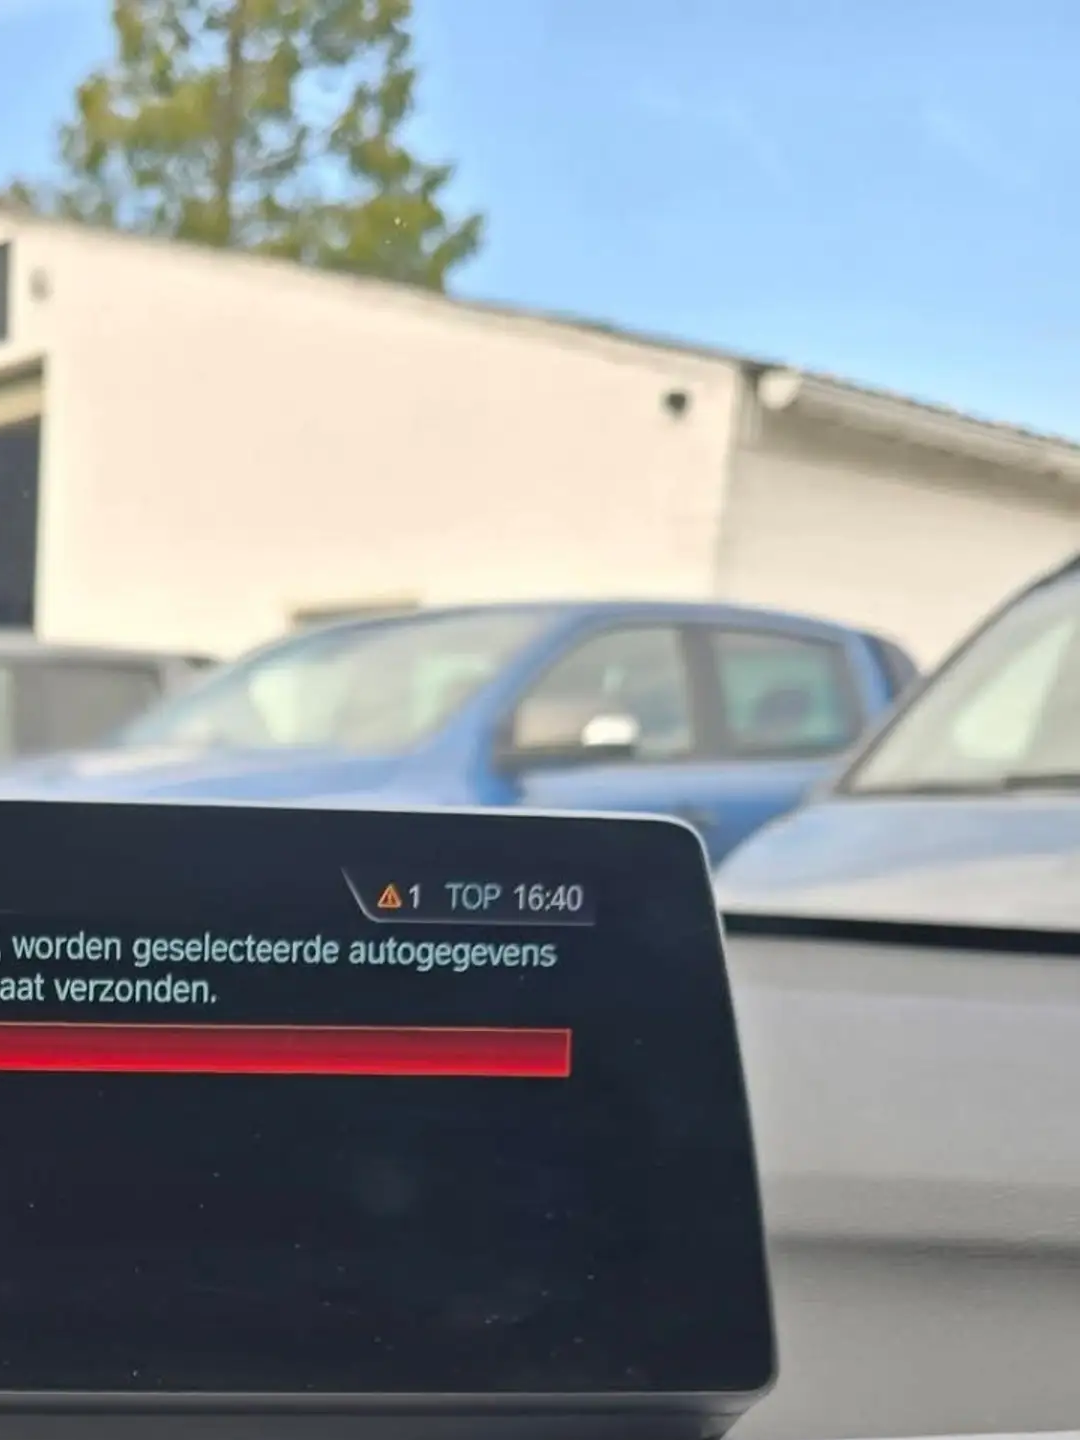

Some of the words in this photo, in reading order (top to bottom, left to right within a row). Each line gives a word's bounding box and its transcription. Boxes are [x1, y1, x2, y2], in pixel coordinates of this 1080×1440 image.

[408, 884, 421, 910] 1
[445, 883, 502, 911] TOP
[513, 884, 584, 912] 16:40
[12, 931, 122, 961] worden
[132, 932, 339, 968] geselecteerde
[348, 940, 558, 972] autogegevens
[53, 976, 218, 1005] verzonden.
